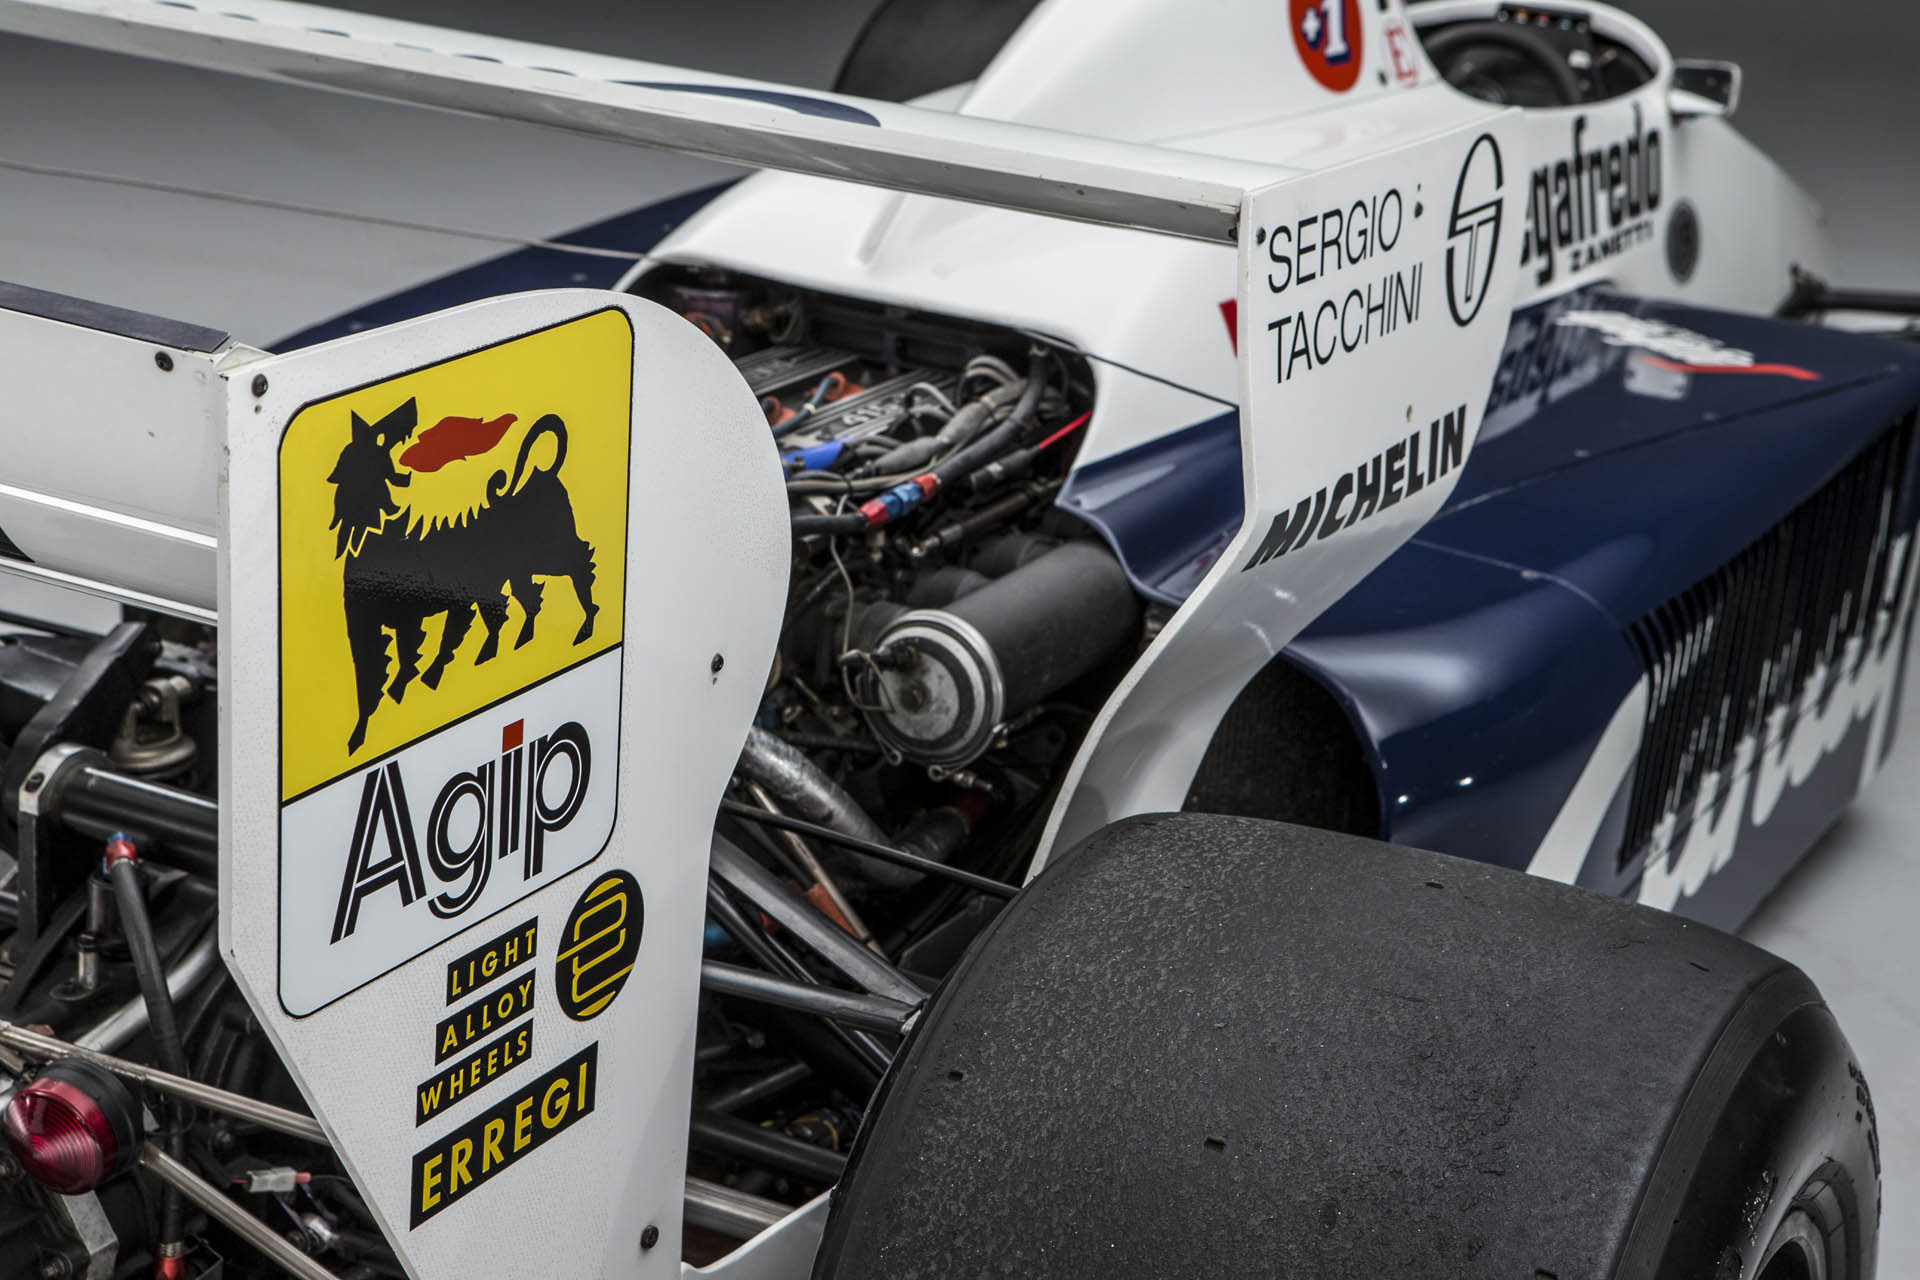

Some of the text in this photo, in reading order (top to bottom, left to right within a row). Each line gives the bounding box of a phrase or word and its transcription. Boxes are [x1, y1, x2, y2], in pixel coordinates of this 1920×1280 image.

[1268, 188, 1402, 293] SERGIO
[1571, 219, 1654, 273] ZANETTI
[1268, 262, 1422, 384] TACCHINI
[1240, 403, 1466, 573] MICHELIN
[330, 718, 591, 945] Agip
[452, 928, 535, 996] LIGHT
[441, 980, 532, 1054] ALLOY
[421, 1030, 527, 1115] WHEELS
[422, 1062, 587, 1213] ERREGI
